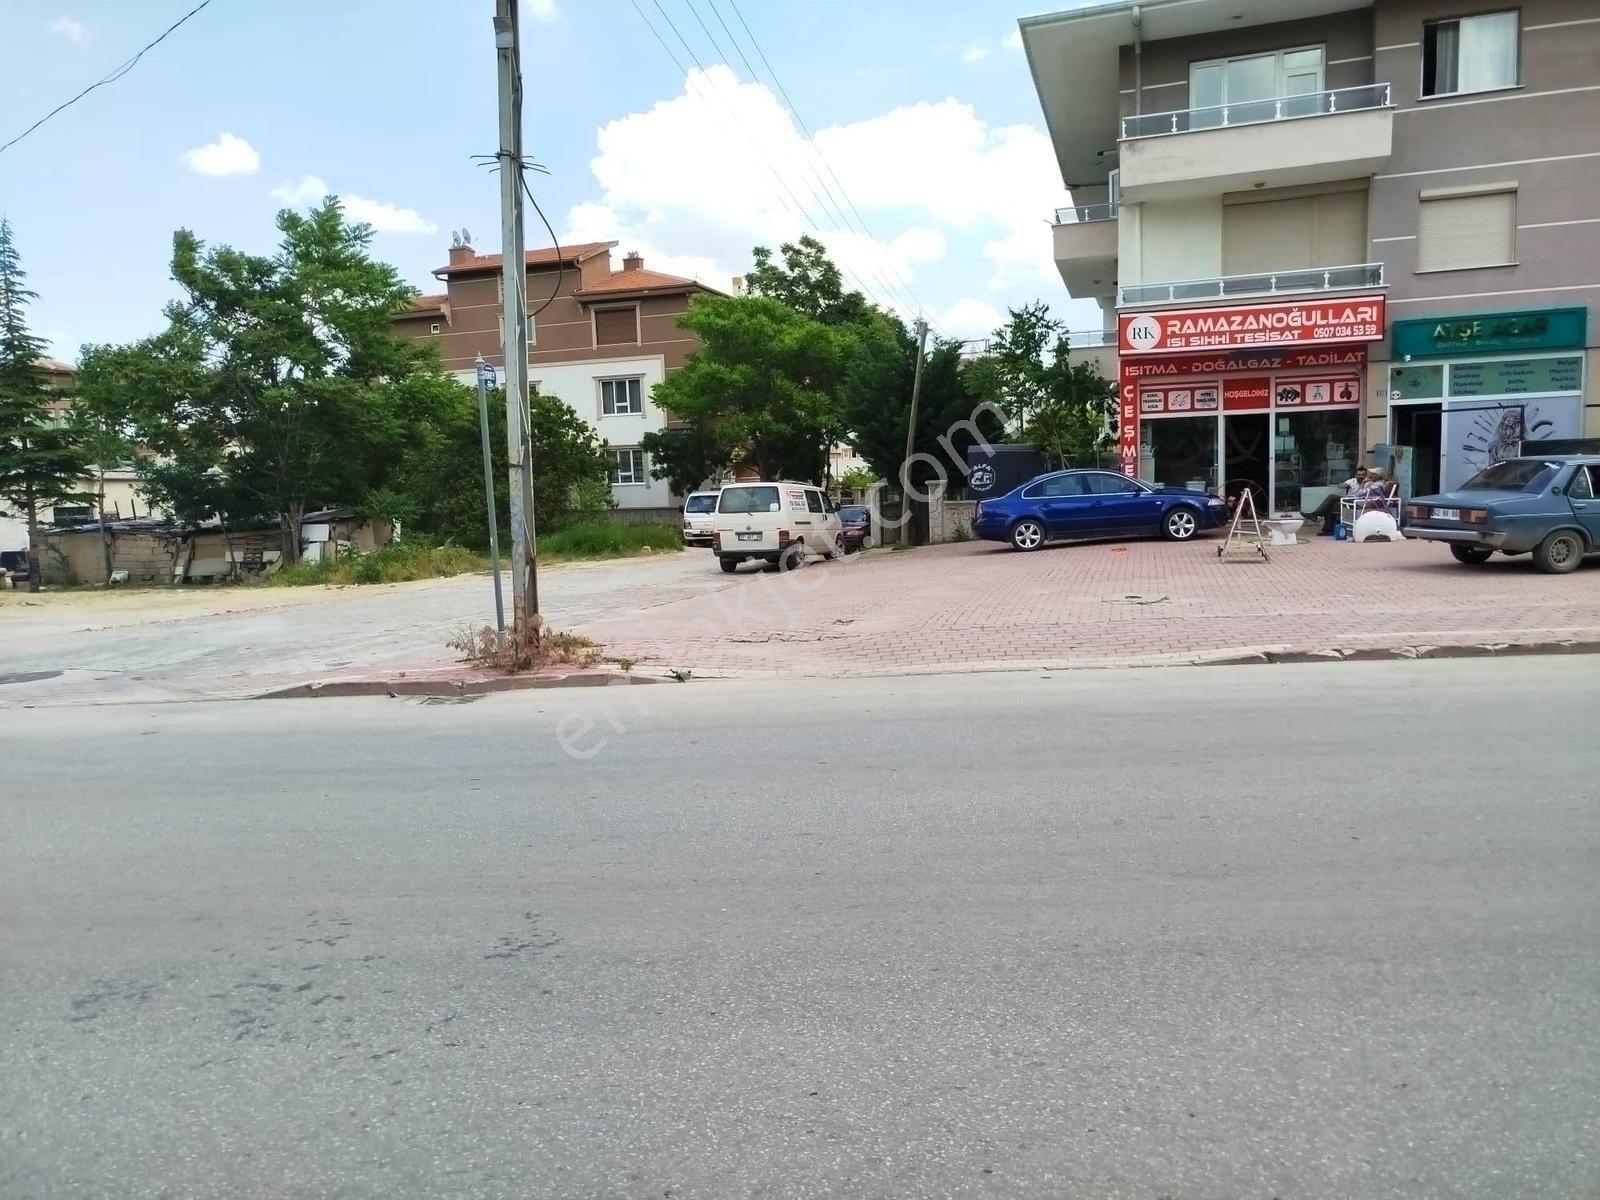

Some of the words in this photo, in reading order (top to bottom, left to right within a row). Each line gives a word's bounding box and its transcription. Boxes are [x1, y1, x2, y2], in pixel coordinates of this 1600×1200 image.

[1167, 305, 1377, 335] RAMAZANOĞULLARI
[1132, 325, 1155, 340] RK
[1167, 337, 1185, 347] ISI
[1189, 332, 1230, 346] SIHHİ
[1234, 329, 1302, 343] TESİSAT
[1313, 326, 1334, 338] 0507
[1335, 325, 1351, 337] 034
[1353, 325, 1364, 336] 53
[1365, 324, 1377, 335] 59
[1125, 363, 1178, 376] ISITMA
[1191, 357, 1282, 372] DOĞALGAZ
[1296, 351, 1365, 366] TADİLAT
